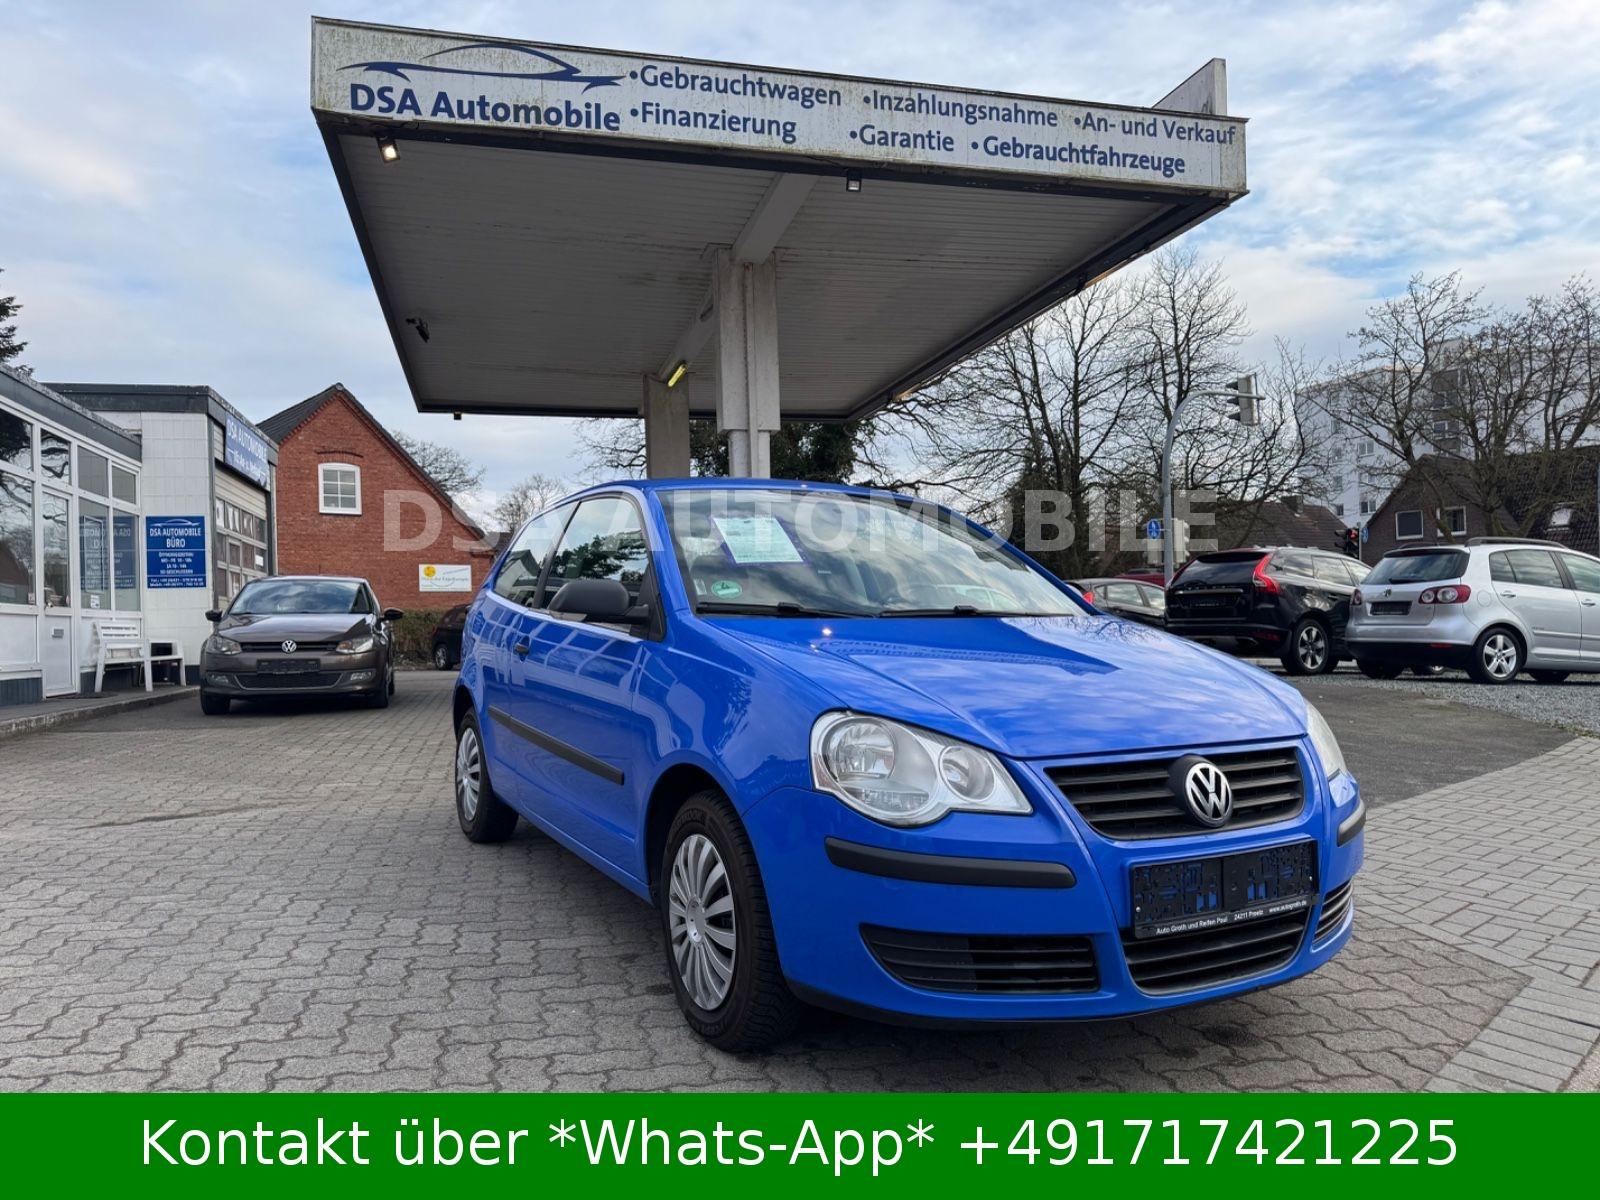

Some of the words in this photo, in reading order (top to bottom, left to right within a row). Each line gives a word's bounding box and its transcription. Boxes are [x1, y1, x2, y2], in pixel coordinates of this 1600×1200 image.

[641, 64, 841, 109] Gebrauchtwagen
[351, 84, 422, 116] DSA
[431, 90, 621, 130] Automobile
[642, 102, 796, 142] Finanzierung
[873, 89, 1058, 125] Inzahlungsnahme
[859, 124, 955, 152] Garantie
[1083, 111, 1117, 133] An-
[1122, 118, 1157, 139] und
[1163, 119, 1236, 145] Verkauf
[982, 135, 1186, 178] Gebrauchtfahrzeuge
[150, 528, 161, 537] DSA
[163, 528, 202, 537] AUTOMOBILE
[166, 537, 186, 548] BÜRO
[1156, 927, 1170, 935] Auto
[1171, 924, 1187, 932] Groth
